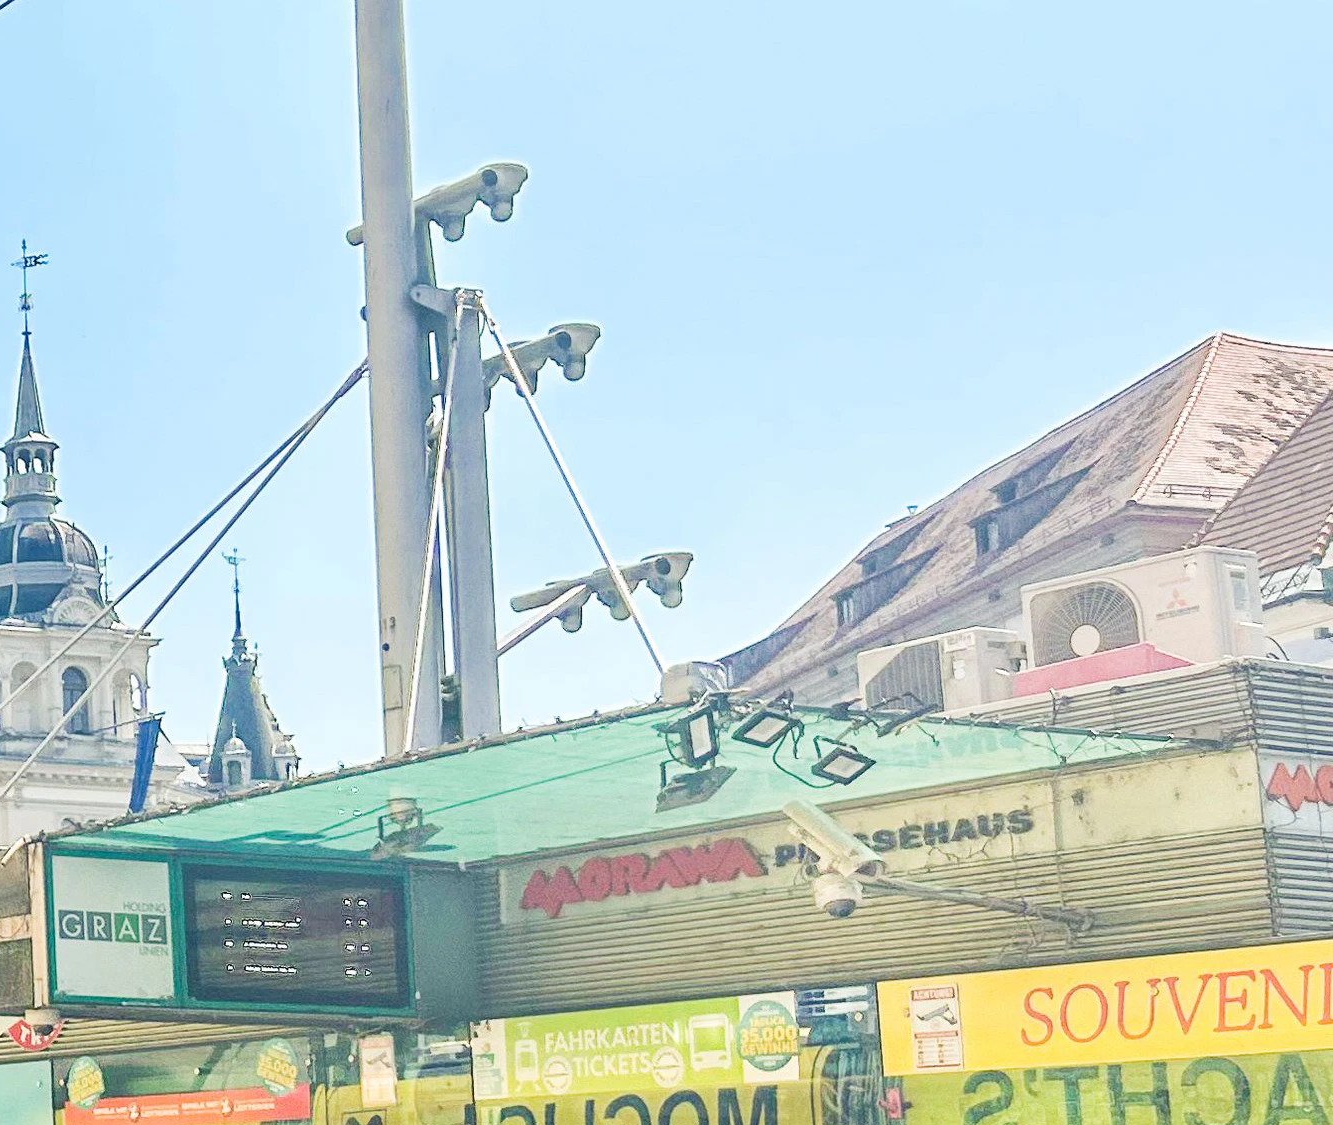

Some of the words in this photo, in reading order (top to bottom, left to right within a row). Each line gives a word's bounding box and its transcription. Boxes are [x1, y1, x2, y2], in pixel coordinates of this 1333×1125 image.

[520, 836, 770, 918] MORAWA
[60, 912, 165, 943] GRAZ
[545, 1018, 680, 1053] FAHRKARTEN
[572, 1051, 652, 1078] TICKETS
